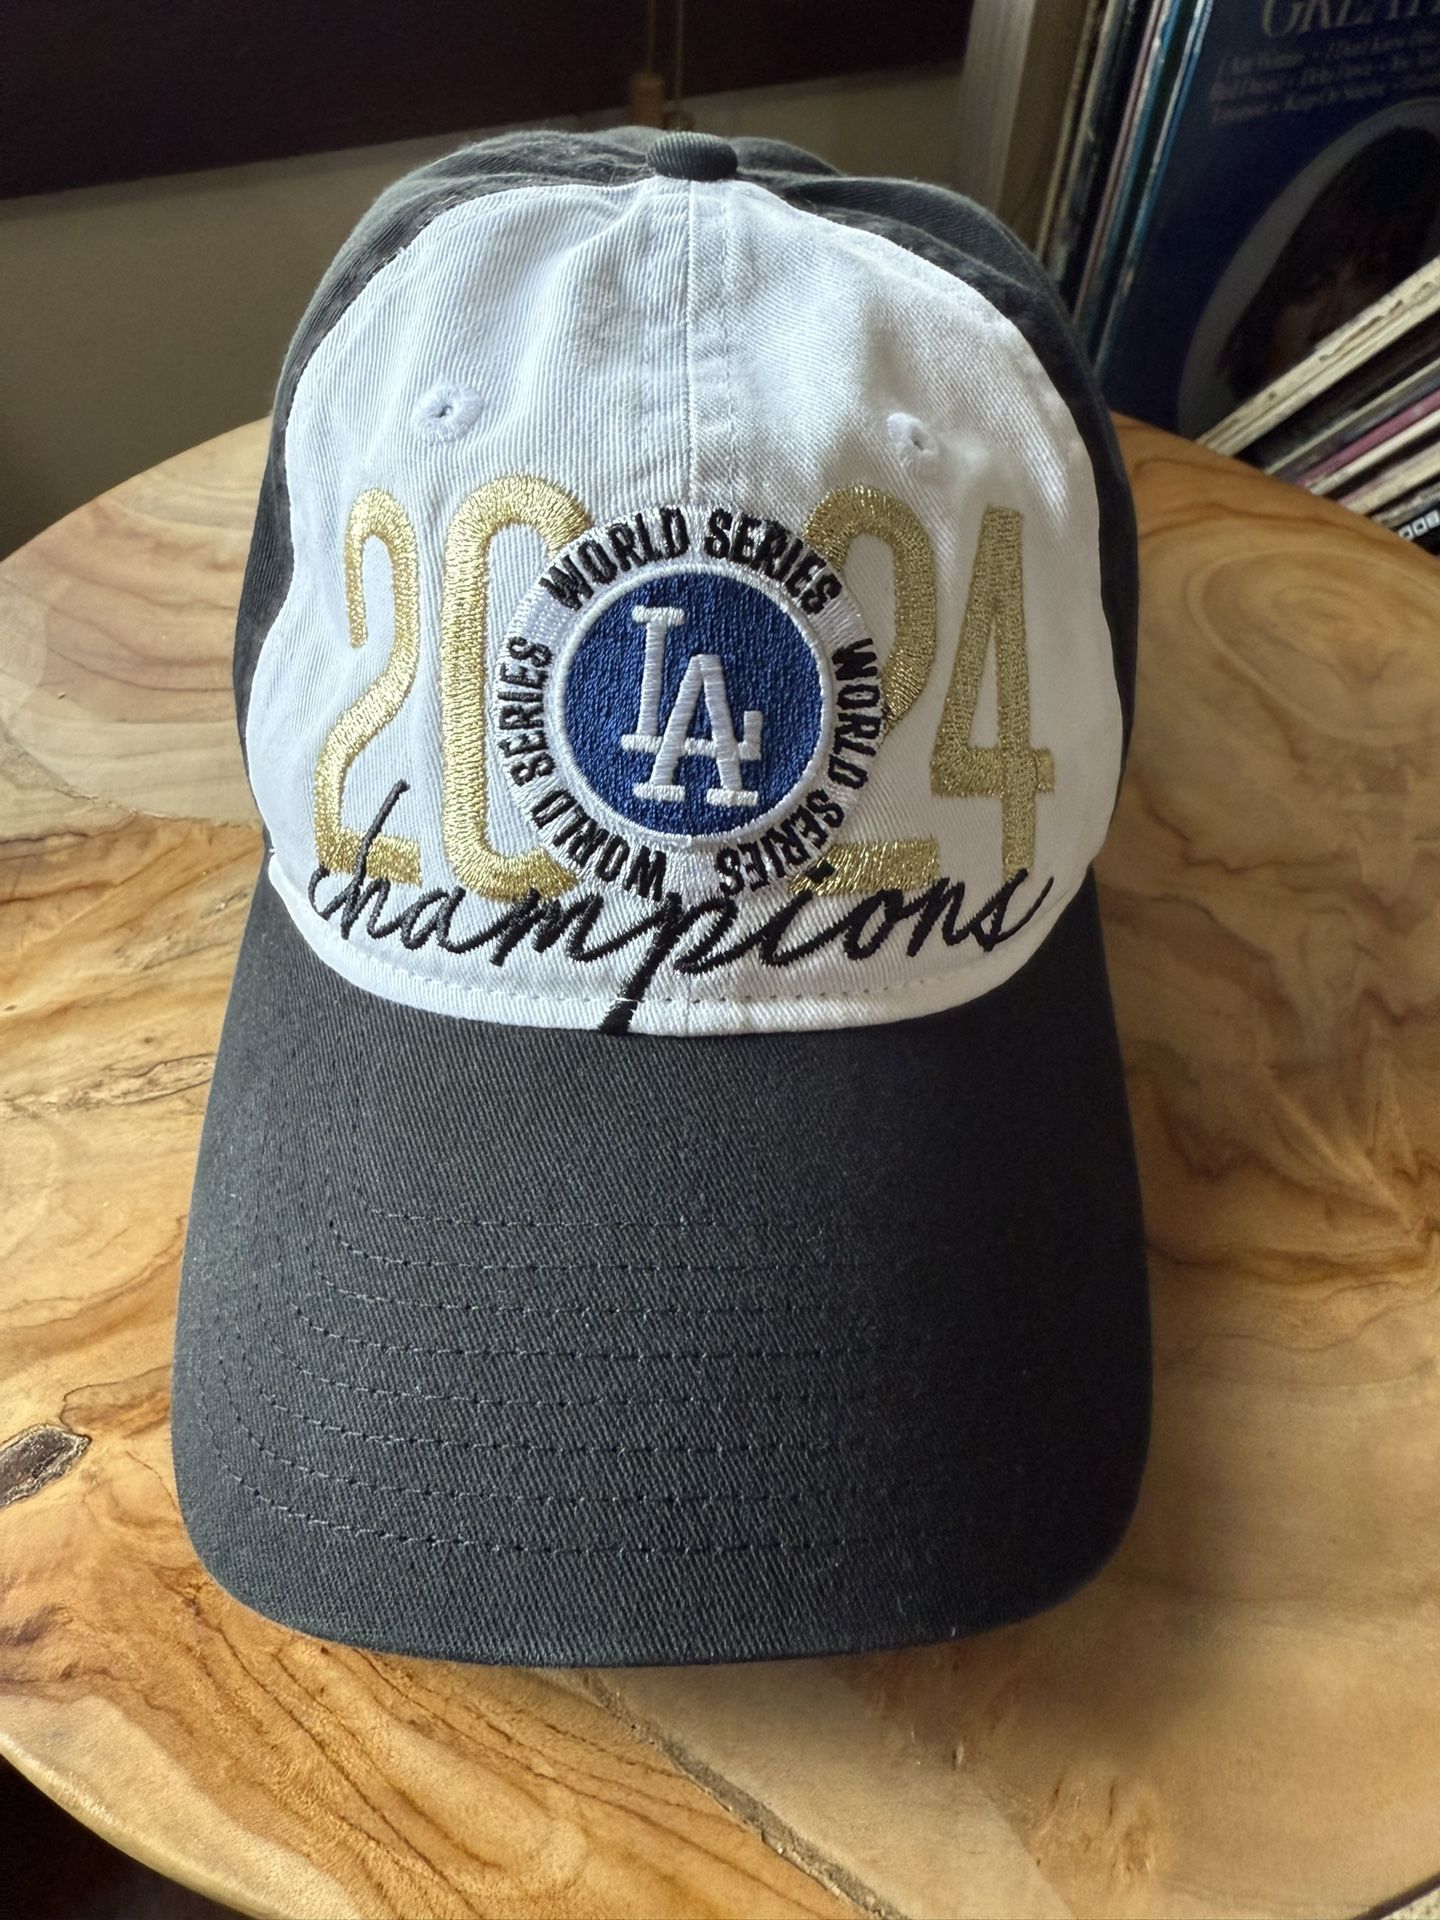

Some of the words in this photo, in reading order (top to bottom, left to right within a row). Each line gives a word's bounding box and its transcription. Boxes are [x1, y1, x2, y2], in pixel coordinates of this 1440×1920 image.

[539, 507, 691, 612] WORLD
[703, 507, 843, 615] SERIES
[499, 636, 553, 787] SERIES
[620, 604, 763, 806] LA
[828, 637, 881, 791] WORLD
[530, 788, 667, 900] WORLD
[714, 790, 845, 897] SERIES
